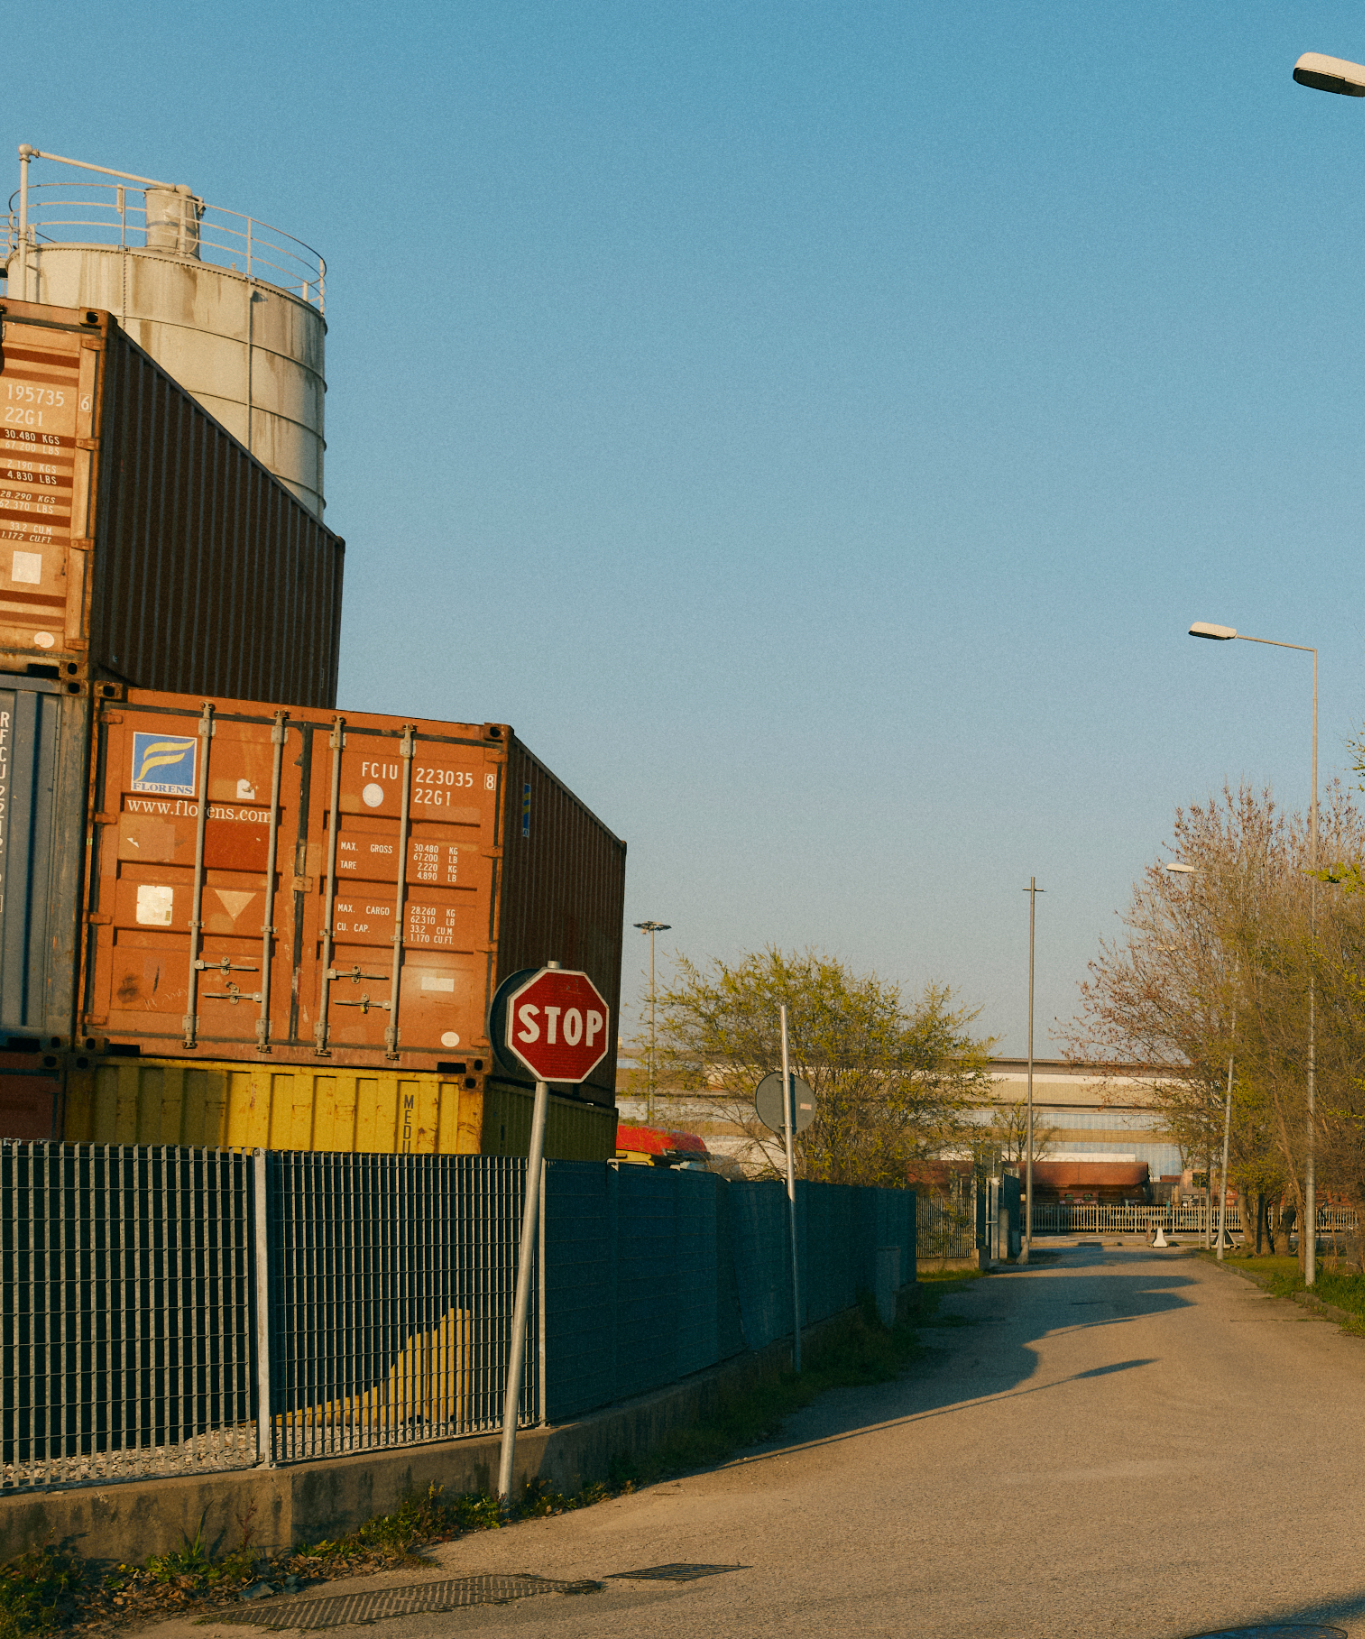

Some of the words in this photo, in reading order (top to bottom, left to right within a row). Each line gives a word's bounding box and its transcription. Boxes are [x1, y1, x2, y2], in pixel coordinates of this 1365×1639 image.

[8, 383, 65, 407] 195735
[80, 395, 90, 410] 6
[4, 406, 43, 427] 22G1
[4, 429, 36, 441] 30.480
[42, 434, 60, 445] KGS
[5, 441, 36, 452] 67.200
[42, 446, 60, 456] LBS
[39, 463, 57, 474] KGS
[7, 470, 33, 482] 4.830
[39, 474, 57, 485] LBS
[0, 490, 32, 501] 28.290
[38, 495, 56, 504] KGS
[36, 504, 54, 514] LBS
[10, 522, 28, 532] 33.2
[1, 531, 24, 541] 1.172
[362, 761, 399, 780] FCIU
[415, 767, 474, 788] 223035
[485, 774, 495, 790] 8
[133, 782, 193, 795] FLORENS
[414, 788, 452, 806] 22G1
[127, 799, 272, 823] www.floens.com
[340, 841, 359, 852] MAX.
[370, 843, 393, 854] GROSS
[413, 843, 439, 854] 30.480
[449, 846, 459, 855] KG
[413, 853, 438, 863] 67.200
[448, 855, 458, 864] LB
[340, 860, 357, 870] TARE
[417, 862, 438, 872] 2.220
[447, 865, 458, 874] KG
[416, 871, 438, 881] 4.890
[447, 873, 457, 883] LB
[337, 903, 356, 913] MAX.
[365, 905, 390, 916] CARGO
[410, 905, 436, 916] 28.260
[446, 908, 456, 918] KG
[410, 915, 436, 925] 62.310
[445, 917, 455, 926] LB
[336, 922, 349, 932] CU.
[353, 923, 370, 933] CAP.
[409, 924, 426, 934] 33.2
[410, 933, 430, 943] 1.170
[517, 1002, 604, 1047] STOP
